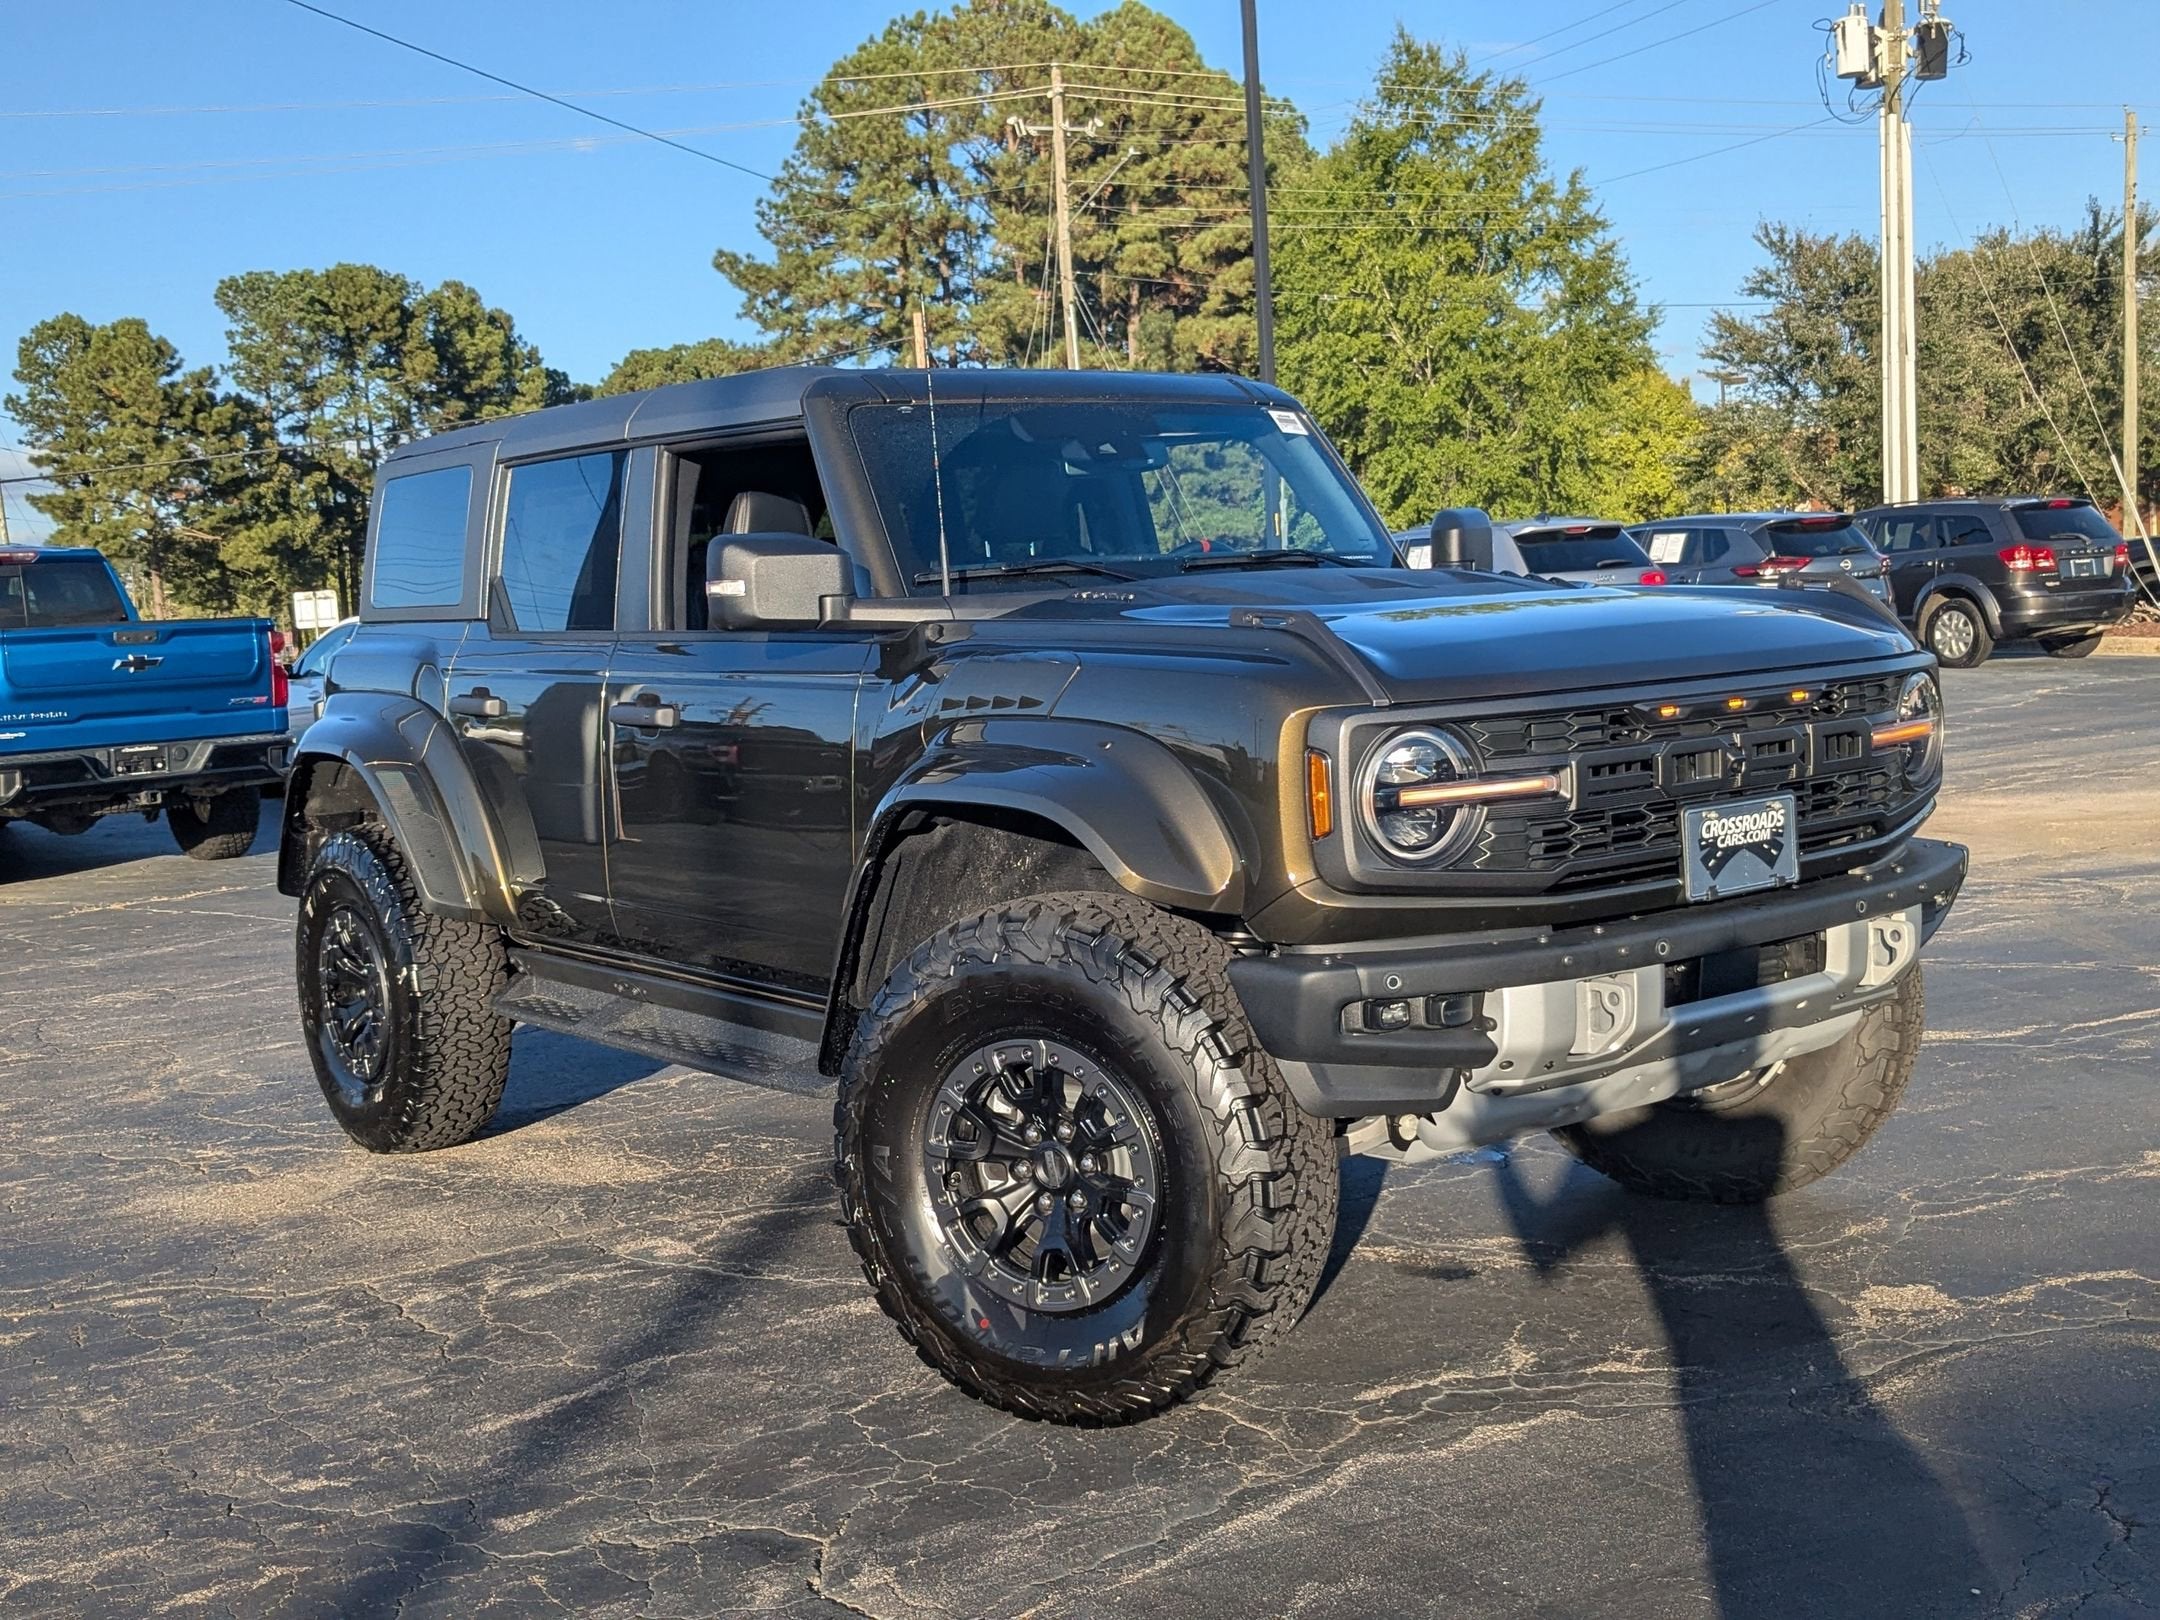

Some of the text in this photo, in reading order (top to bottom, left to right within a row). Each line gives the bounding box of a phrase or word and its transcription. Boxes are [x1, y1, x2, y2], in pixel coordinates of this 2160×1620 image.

[1570, 717, 1872, 811] FORD
[1701, 808, 1785, 839] CROSSROADS
[1716, 828, 1771, 848] CARS.COM
